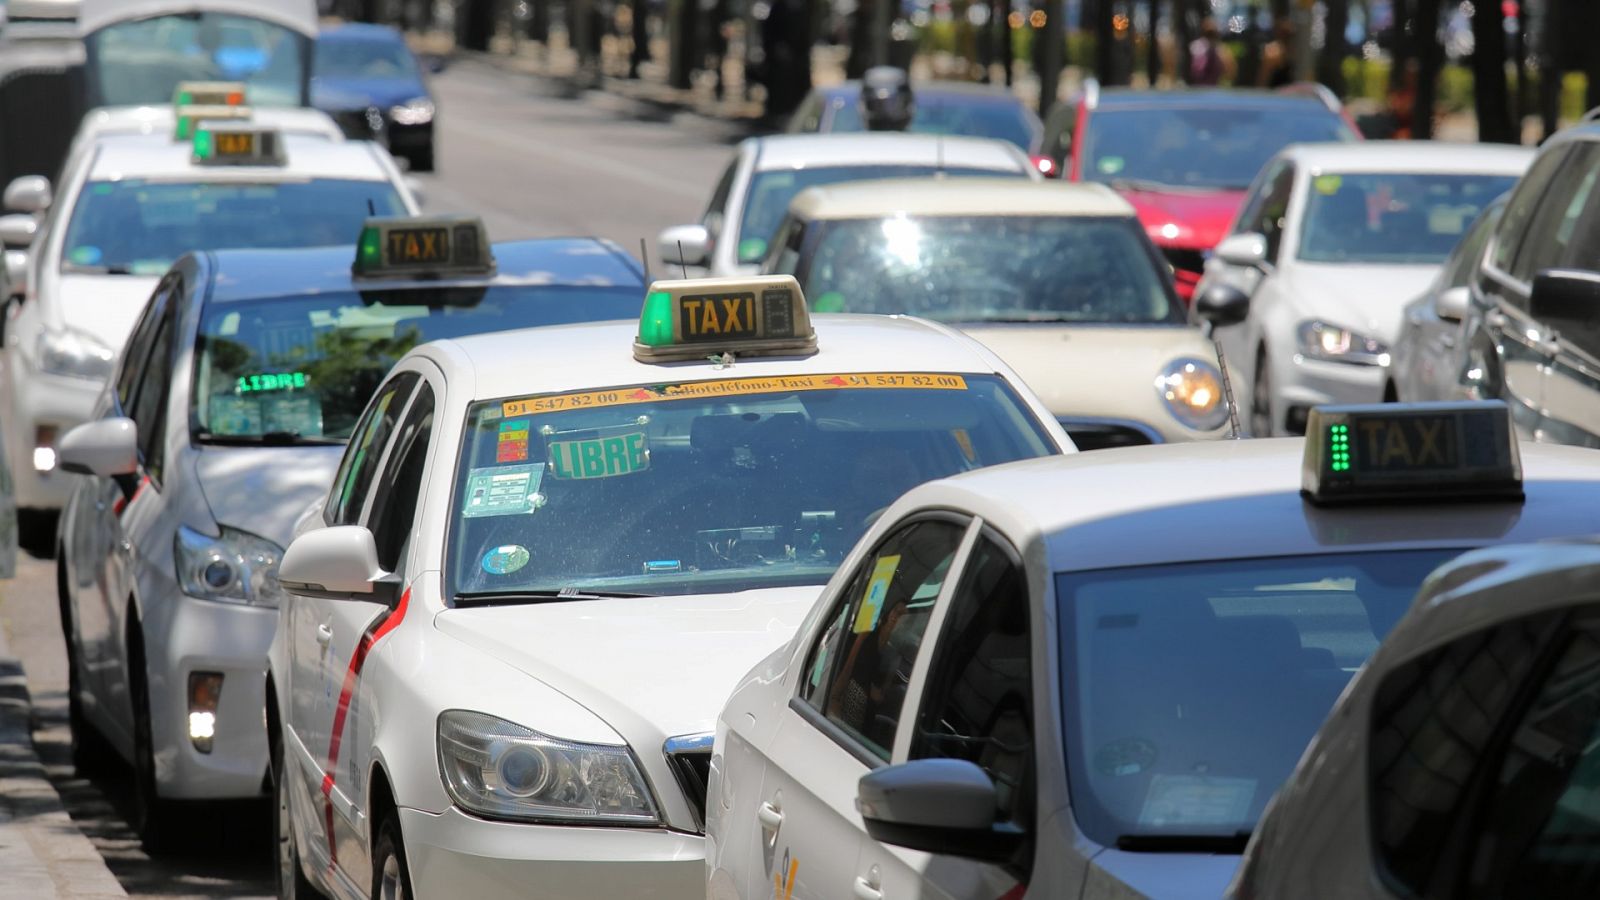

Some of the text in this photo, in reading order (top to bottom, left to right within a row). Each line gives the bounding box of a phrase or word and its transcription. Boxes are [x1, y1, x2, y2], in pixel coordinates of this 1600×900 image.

[389, 231, 447, 258] TAXI
[683, 298, 753, 334] TAXI
[237, 372, 306, 393] LIBRE
[507, 402, 527, 414] 91
[535, 398, 564, 410] 547
[571, 395, 592, 406] 82
[597, 392, 618, 404] 00
[850, 375, 870, 386] 91
[876, 375, 905, 386] 547
[912, 376, 933, 387] 82
[937, 376, 959, 388] 00
[552, 433, 647, 478] LIBRE
[1360, 419, 1453, 466] TAXI
